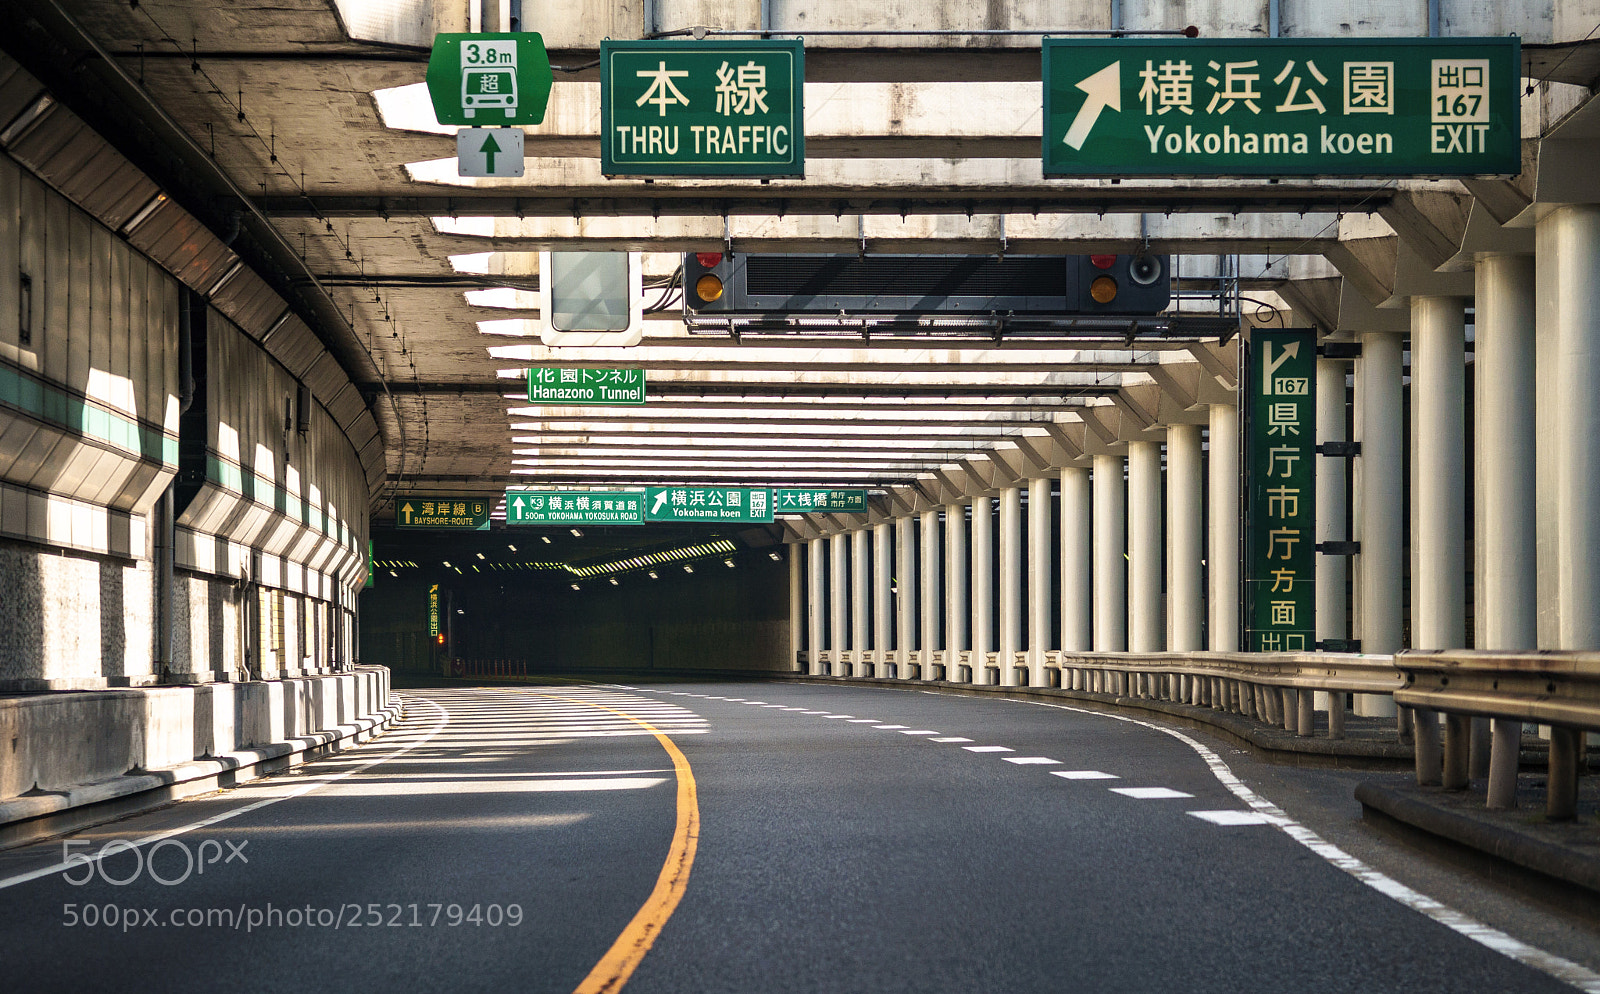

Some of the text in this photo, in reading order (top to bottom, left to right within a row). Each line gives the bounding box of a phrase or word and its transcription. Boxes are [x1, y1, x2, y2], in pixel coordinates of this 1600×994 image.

[466, 44, 512, 64] 3.8m
[480, 74, 499, 94] 超
[1438, 65, 1483, 88] 出口
[635, 60, 769, 116] 本線
[1138, 59, 1395, 115] 横浜公園
[1436, 94, 1482, 117] 167
[617, 125, 789, 155] THRU TRAFFIC
[1144, 125, 1393, 154] Yokohama koen
[1431, 124, 1490, 153] EXIT
[533, 385, 640, 399] Hanazono Tunnel
[1277, 379, 1306, 393] 167
[530, 498, 543, 506] K3
[548, 496, 637, 511] 横浜横須賀道路
[671, 490, 741, 507] 横浜公園
[782, 492, 828, 507] 大桟橋
[847, 495, 862, 504] 方面
[421, 502, 467, 516] 湾岸線
[475, 504, 482, 513] B
[525, 512, 545, 520] 500m
[548, 512, 638, 520] YOKOHAMA YOKOSUKA ROAD
[673, 508, 741, 518] Yokohama koen
[750, 509, 766, 518] EXIT
